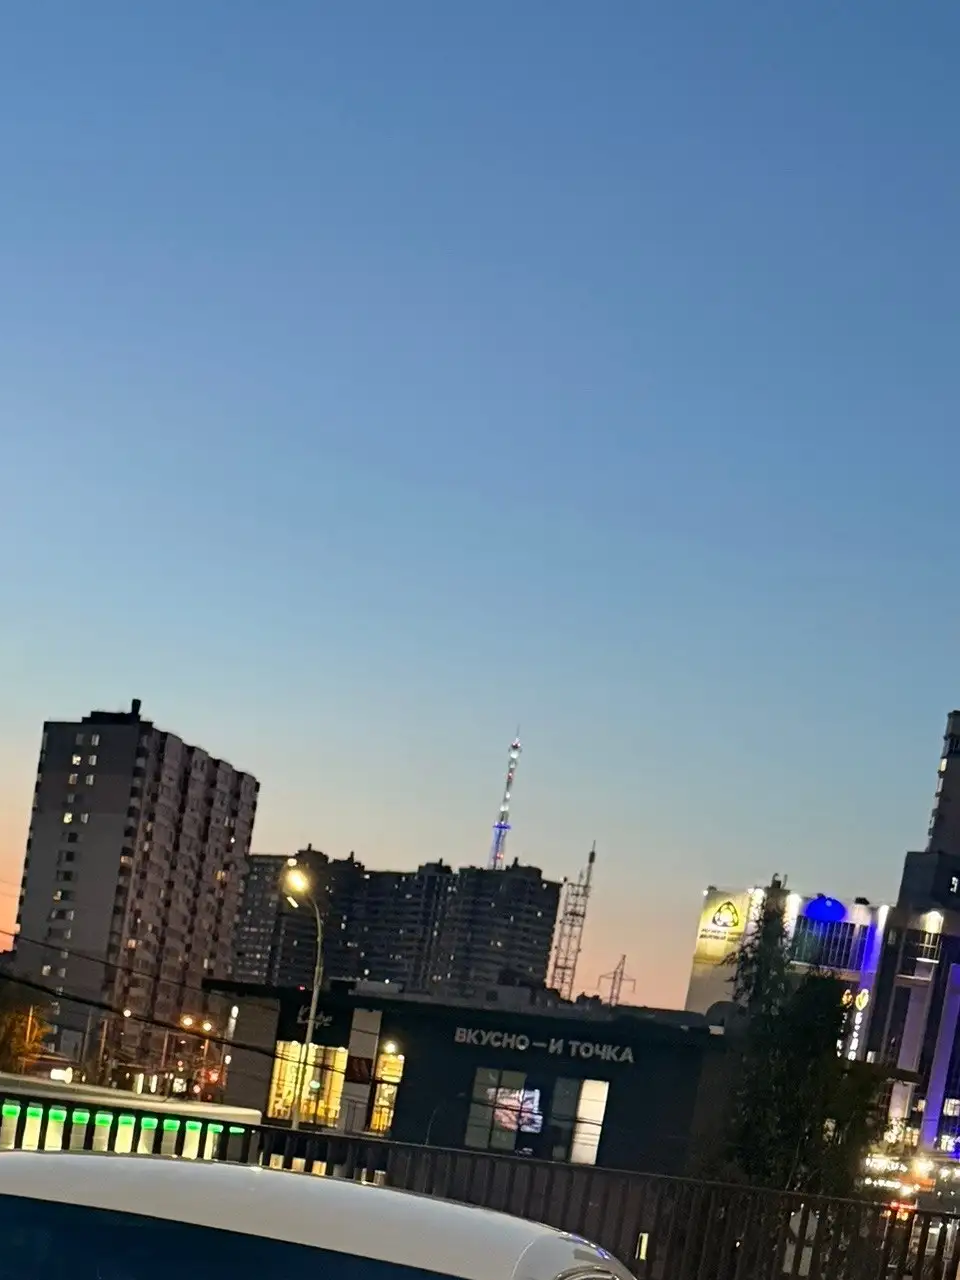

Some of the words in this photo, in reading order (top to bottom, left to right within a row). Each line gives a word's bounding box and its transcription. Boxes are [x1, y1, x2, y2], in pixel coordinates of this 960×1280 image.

[454, 1027, 530, 1051] ВКУСНО
[548, 1037, 564, 1055] И
[568, 1039, 635, 1064] ТОЧКА
